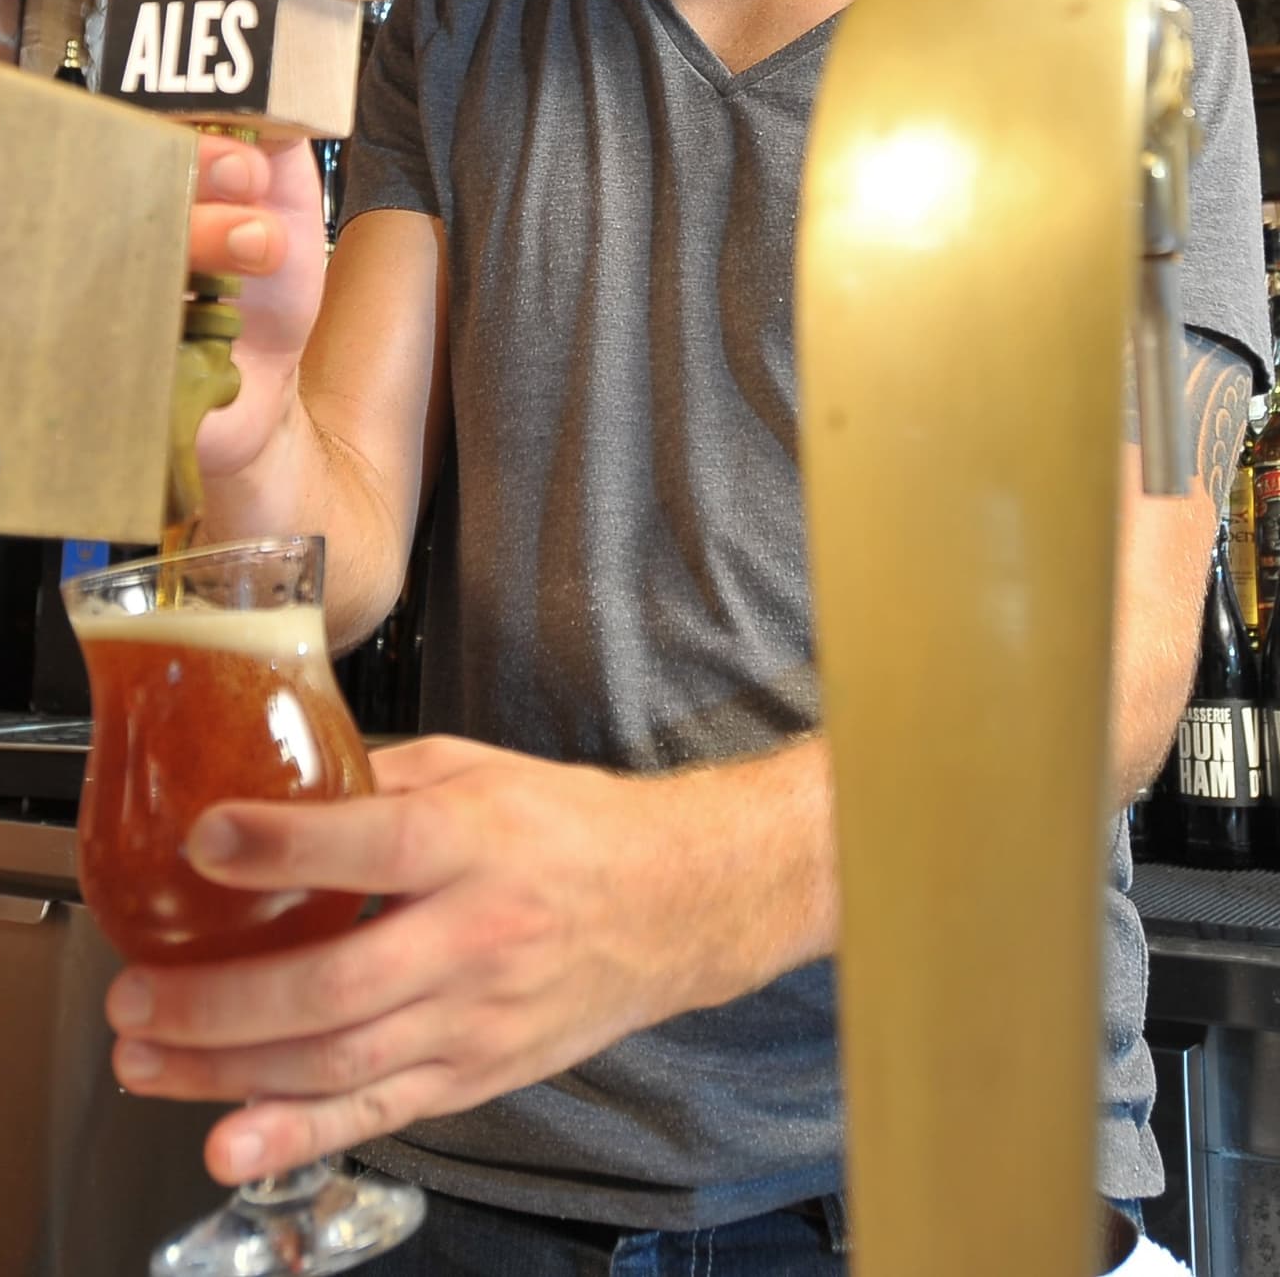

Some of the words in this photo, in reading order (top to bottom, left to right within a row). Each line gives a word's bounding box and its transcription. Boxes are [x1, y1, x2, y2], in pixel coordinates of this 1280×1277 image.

[121, 0, 259, 94] ALES
[1183, 706, 1232, 723] ASSERIE
[1178, 721, 1234, 762] DUN
[1180, 759, 1236, 800] HAM
